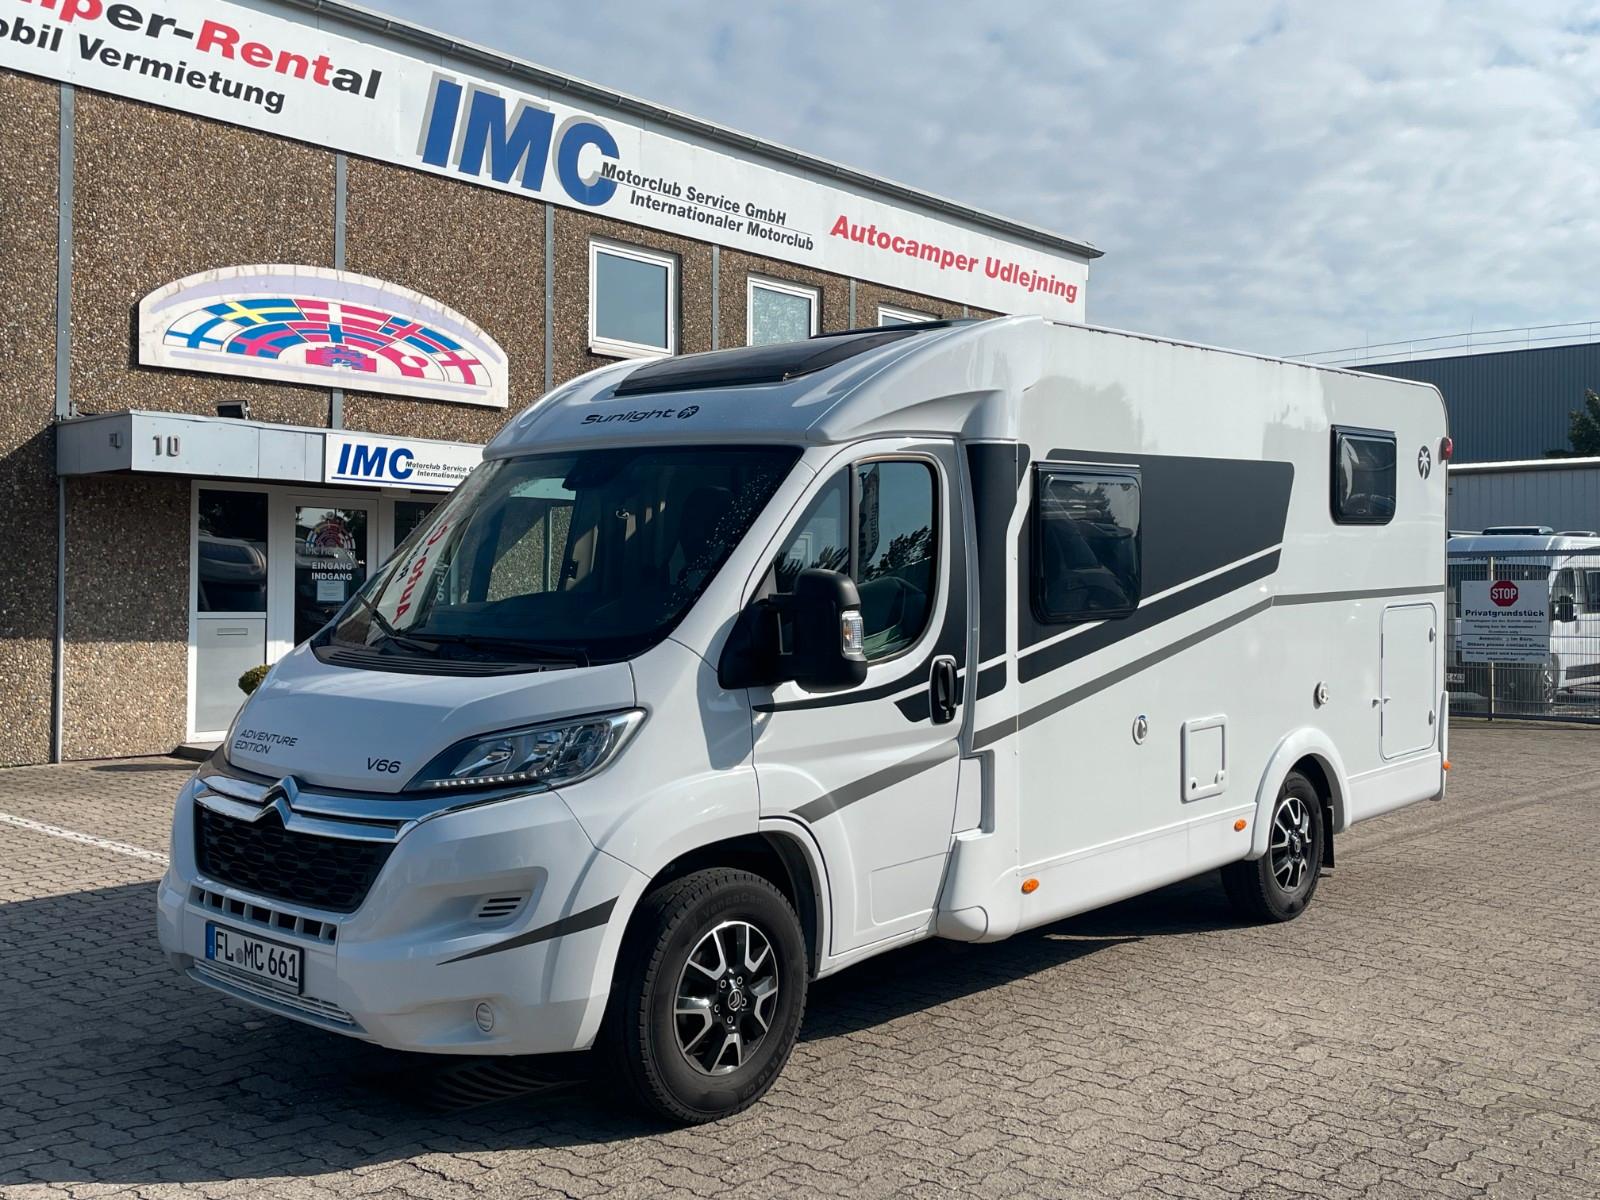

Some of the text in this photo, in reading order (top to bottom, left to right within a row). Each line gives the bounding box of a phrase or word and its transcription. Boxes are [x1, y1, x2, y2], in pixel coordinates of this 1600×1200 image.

[16, 0, 382, 100] per-Rental
[79, 33, 286, 114] Vermietung
[419, 77, 620, 207] IMC
[601, 161, 787, 226] Motorclub Service GmbH
[630, 190, 814, 251] Internationaler Motorclub
[829, 214, 1078, 303] Autocamper Udlejning
[580, 409, 676, 425] Sunlight
[153, 433, 181, 457] 10
[337, 443, 415, 480] IMC
[405, 460, 441, 471] Motorclub
[442, 463, 467, 473] Service
[311, 561, 353, 571] EINGANG
[311, 572, 353, 581] INDGANG
[1492, 587, 1517, 600] STOP
[1464, 609, 1545, 618] Privatgrundstück
[234, 740, 272, 755] EDITION
[239, 728, 299, 747] ADVENTURE
[367, 757, 402, 774] V66
[215, 930, 298, 983] FL MC 661
